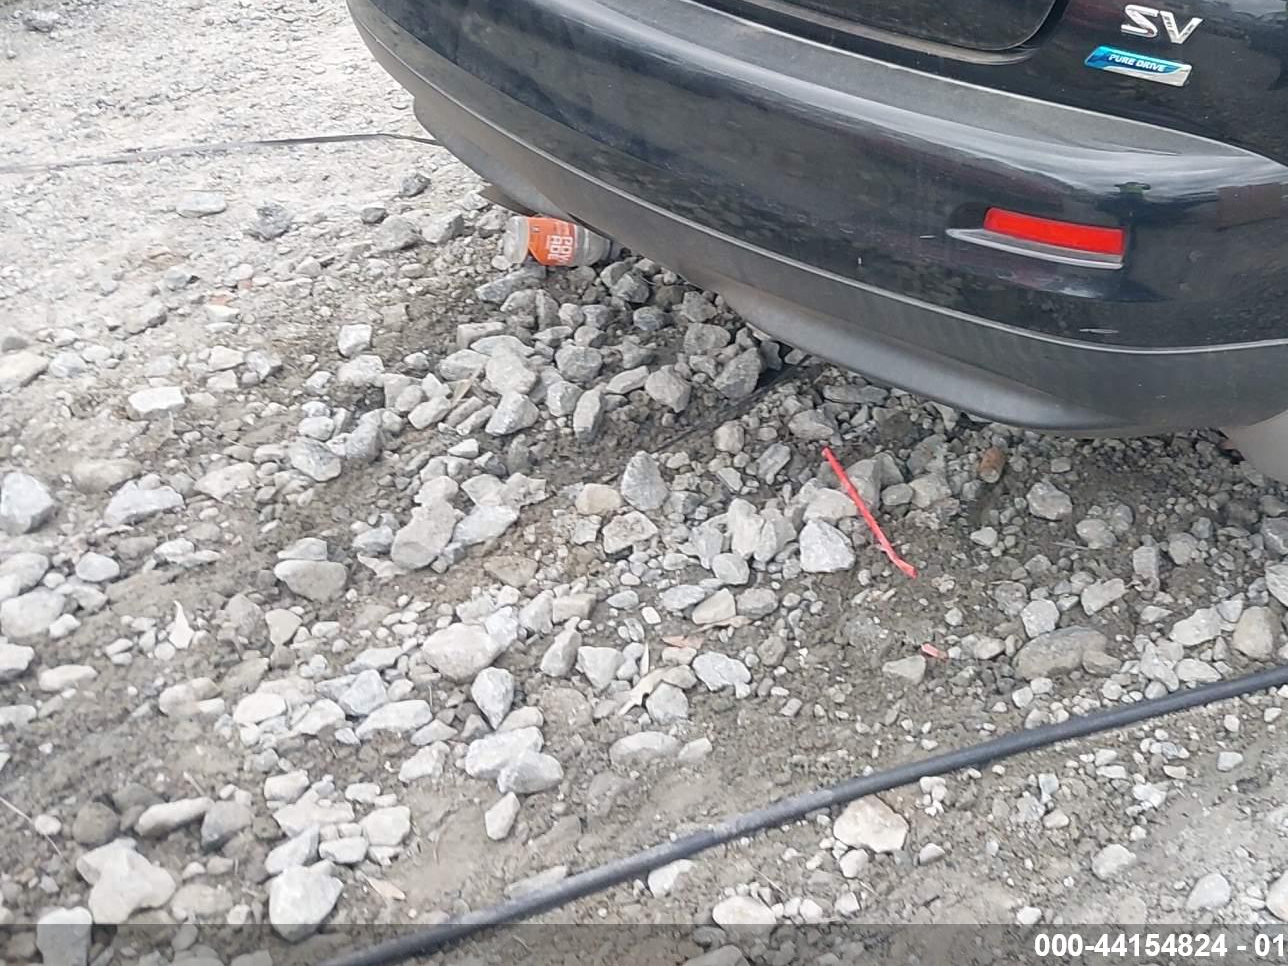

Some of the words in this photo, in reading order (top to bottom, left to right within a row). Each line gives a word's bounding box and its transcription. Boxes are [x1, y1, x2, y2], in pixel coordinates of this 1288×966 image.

[1121, 4, 1203, 44] SV
[1108, 53, 1135, 66] PURE
[1136, 60, 1169, 73] DRIVE
